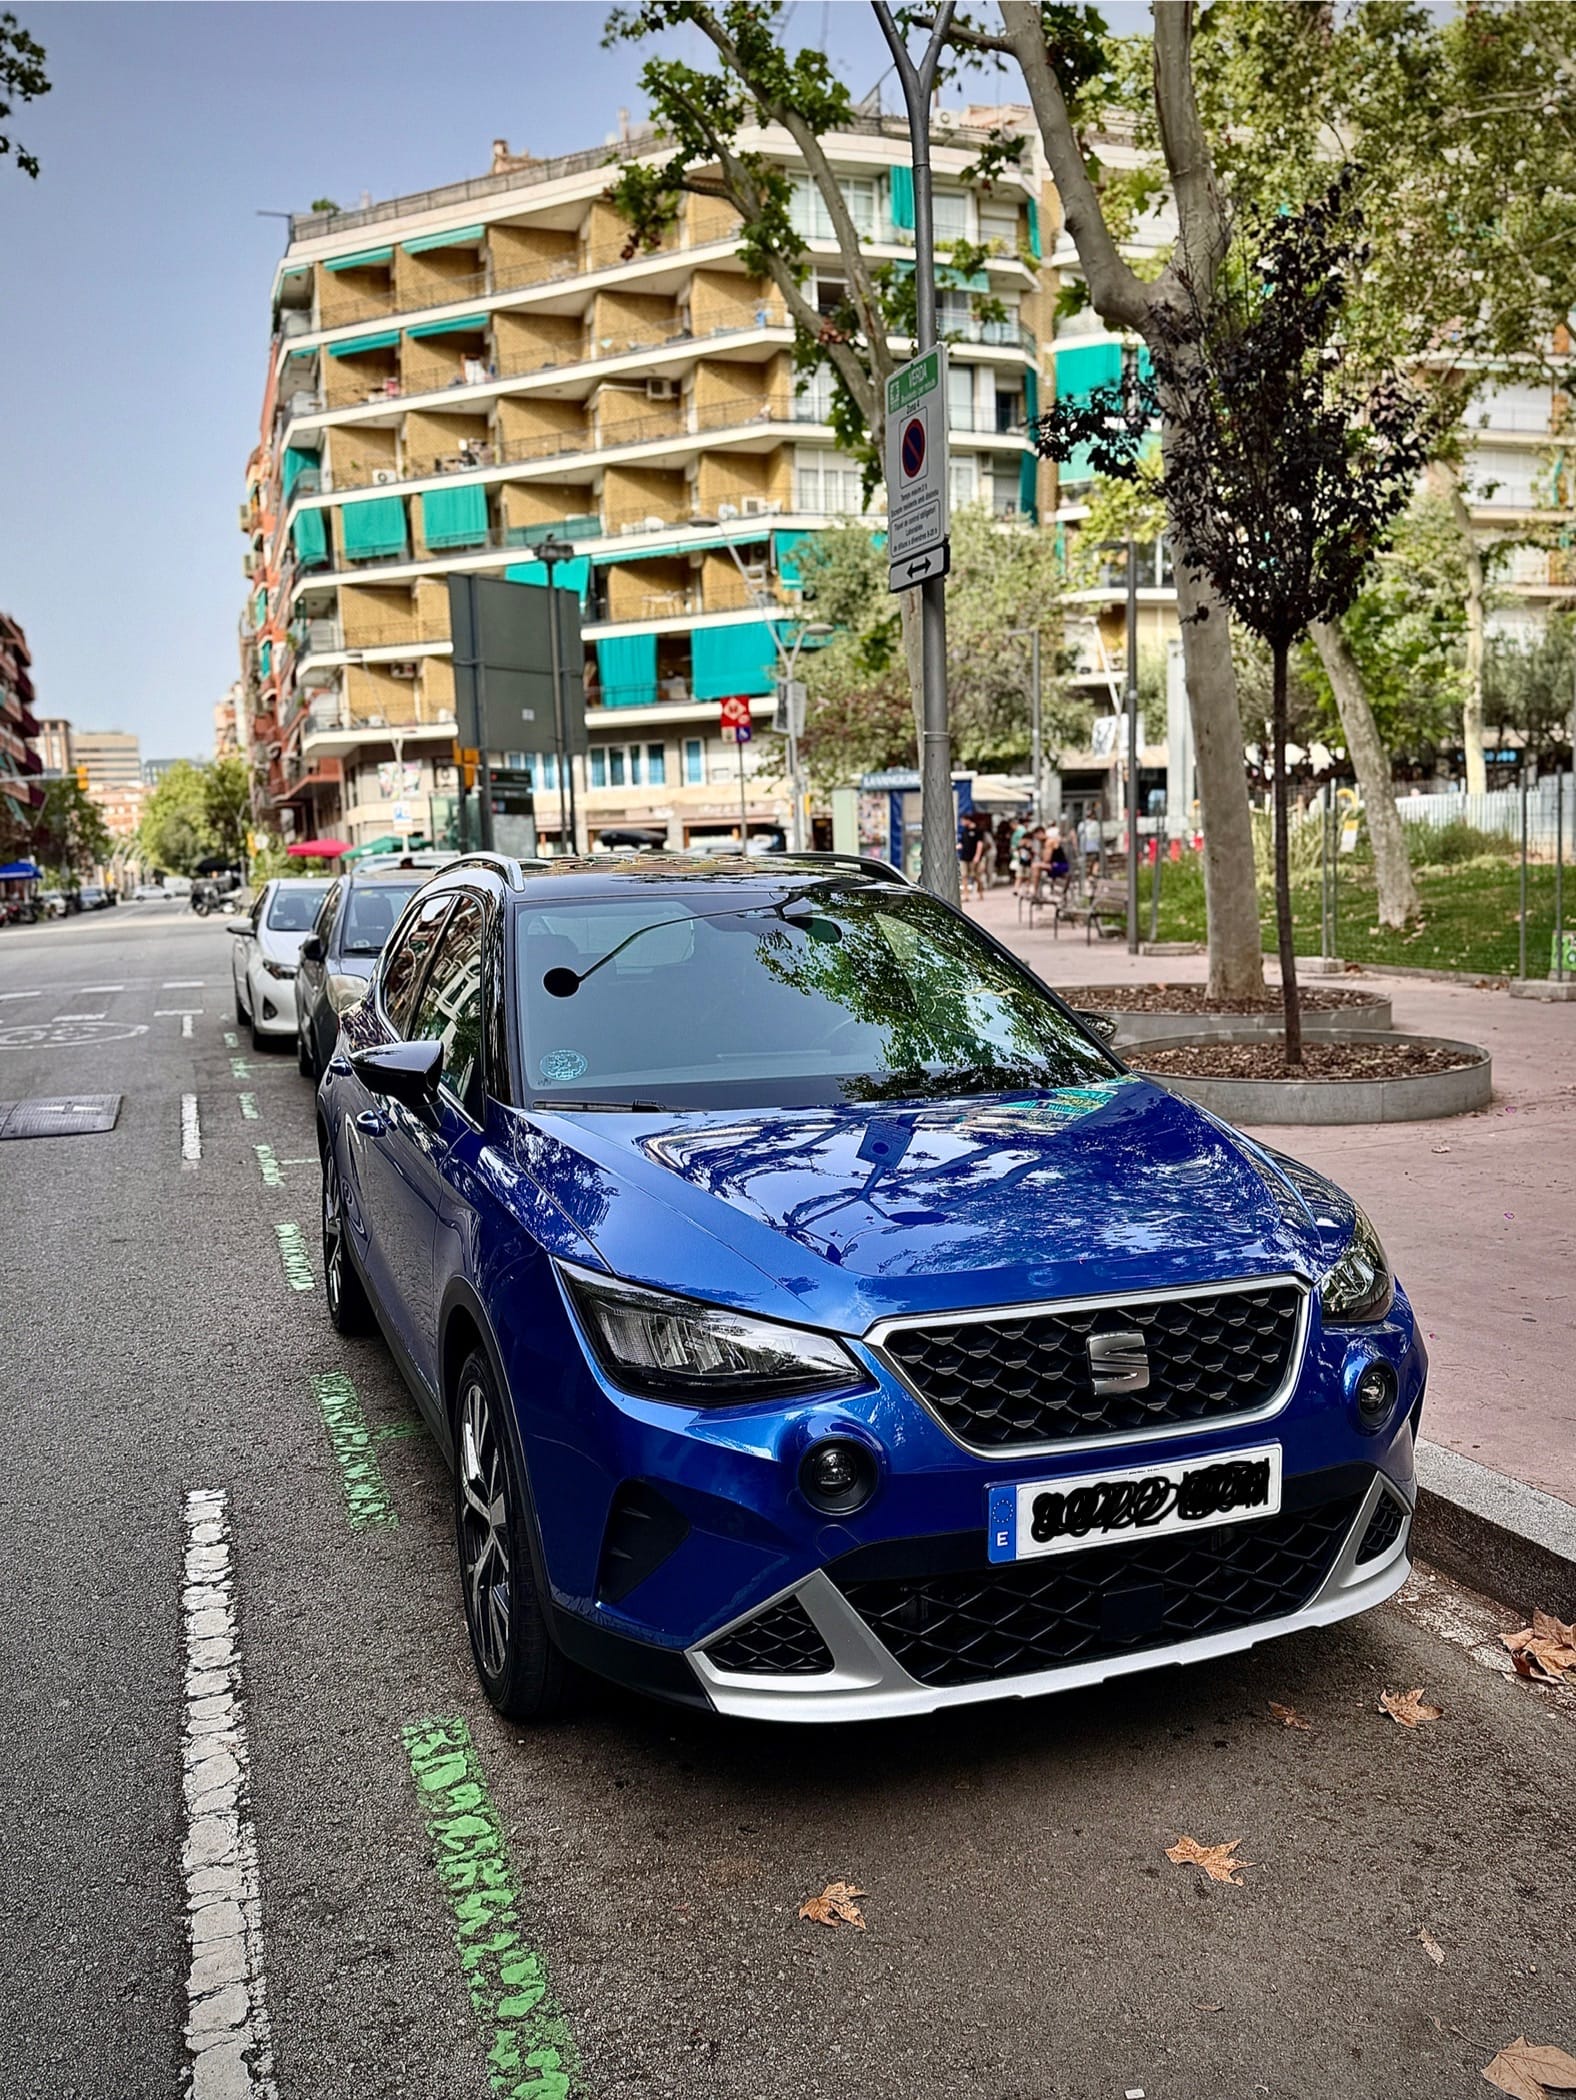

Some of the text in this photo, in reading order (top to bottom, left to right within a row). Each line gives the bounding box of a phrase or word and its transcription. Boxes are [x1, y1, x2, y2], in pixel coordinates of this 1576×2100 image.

[908, 362, 927, 389] VERDA
[906, 402, 916, 414] Zona
[997, 1531, 1008, 1547] E
